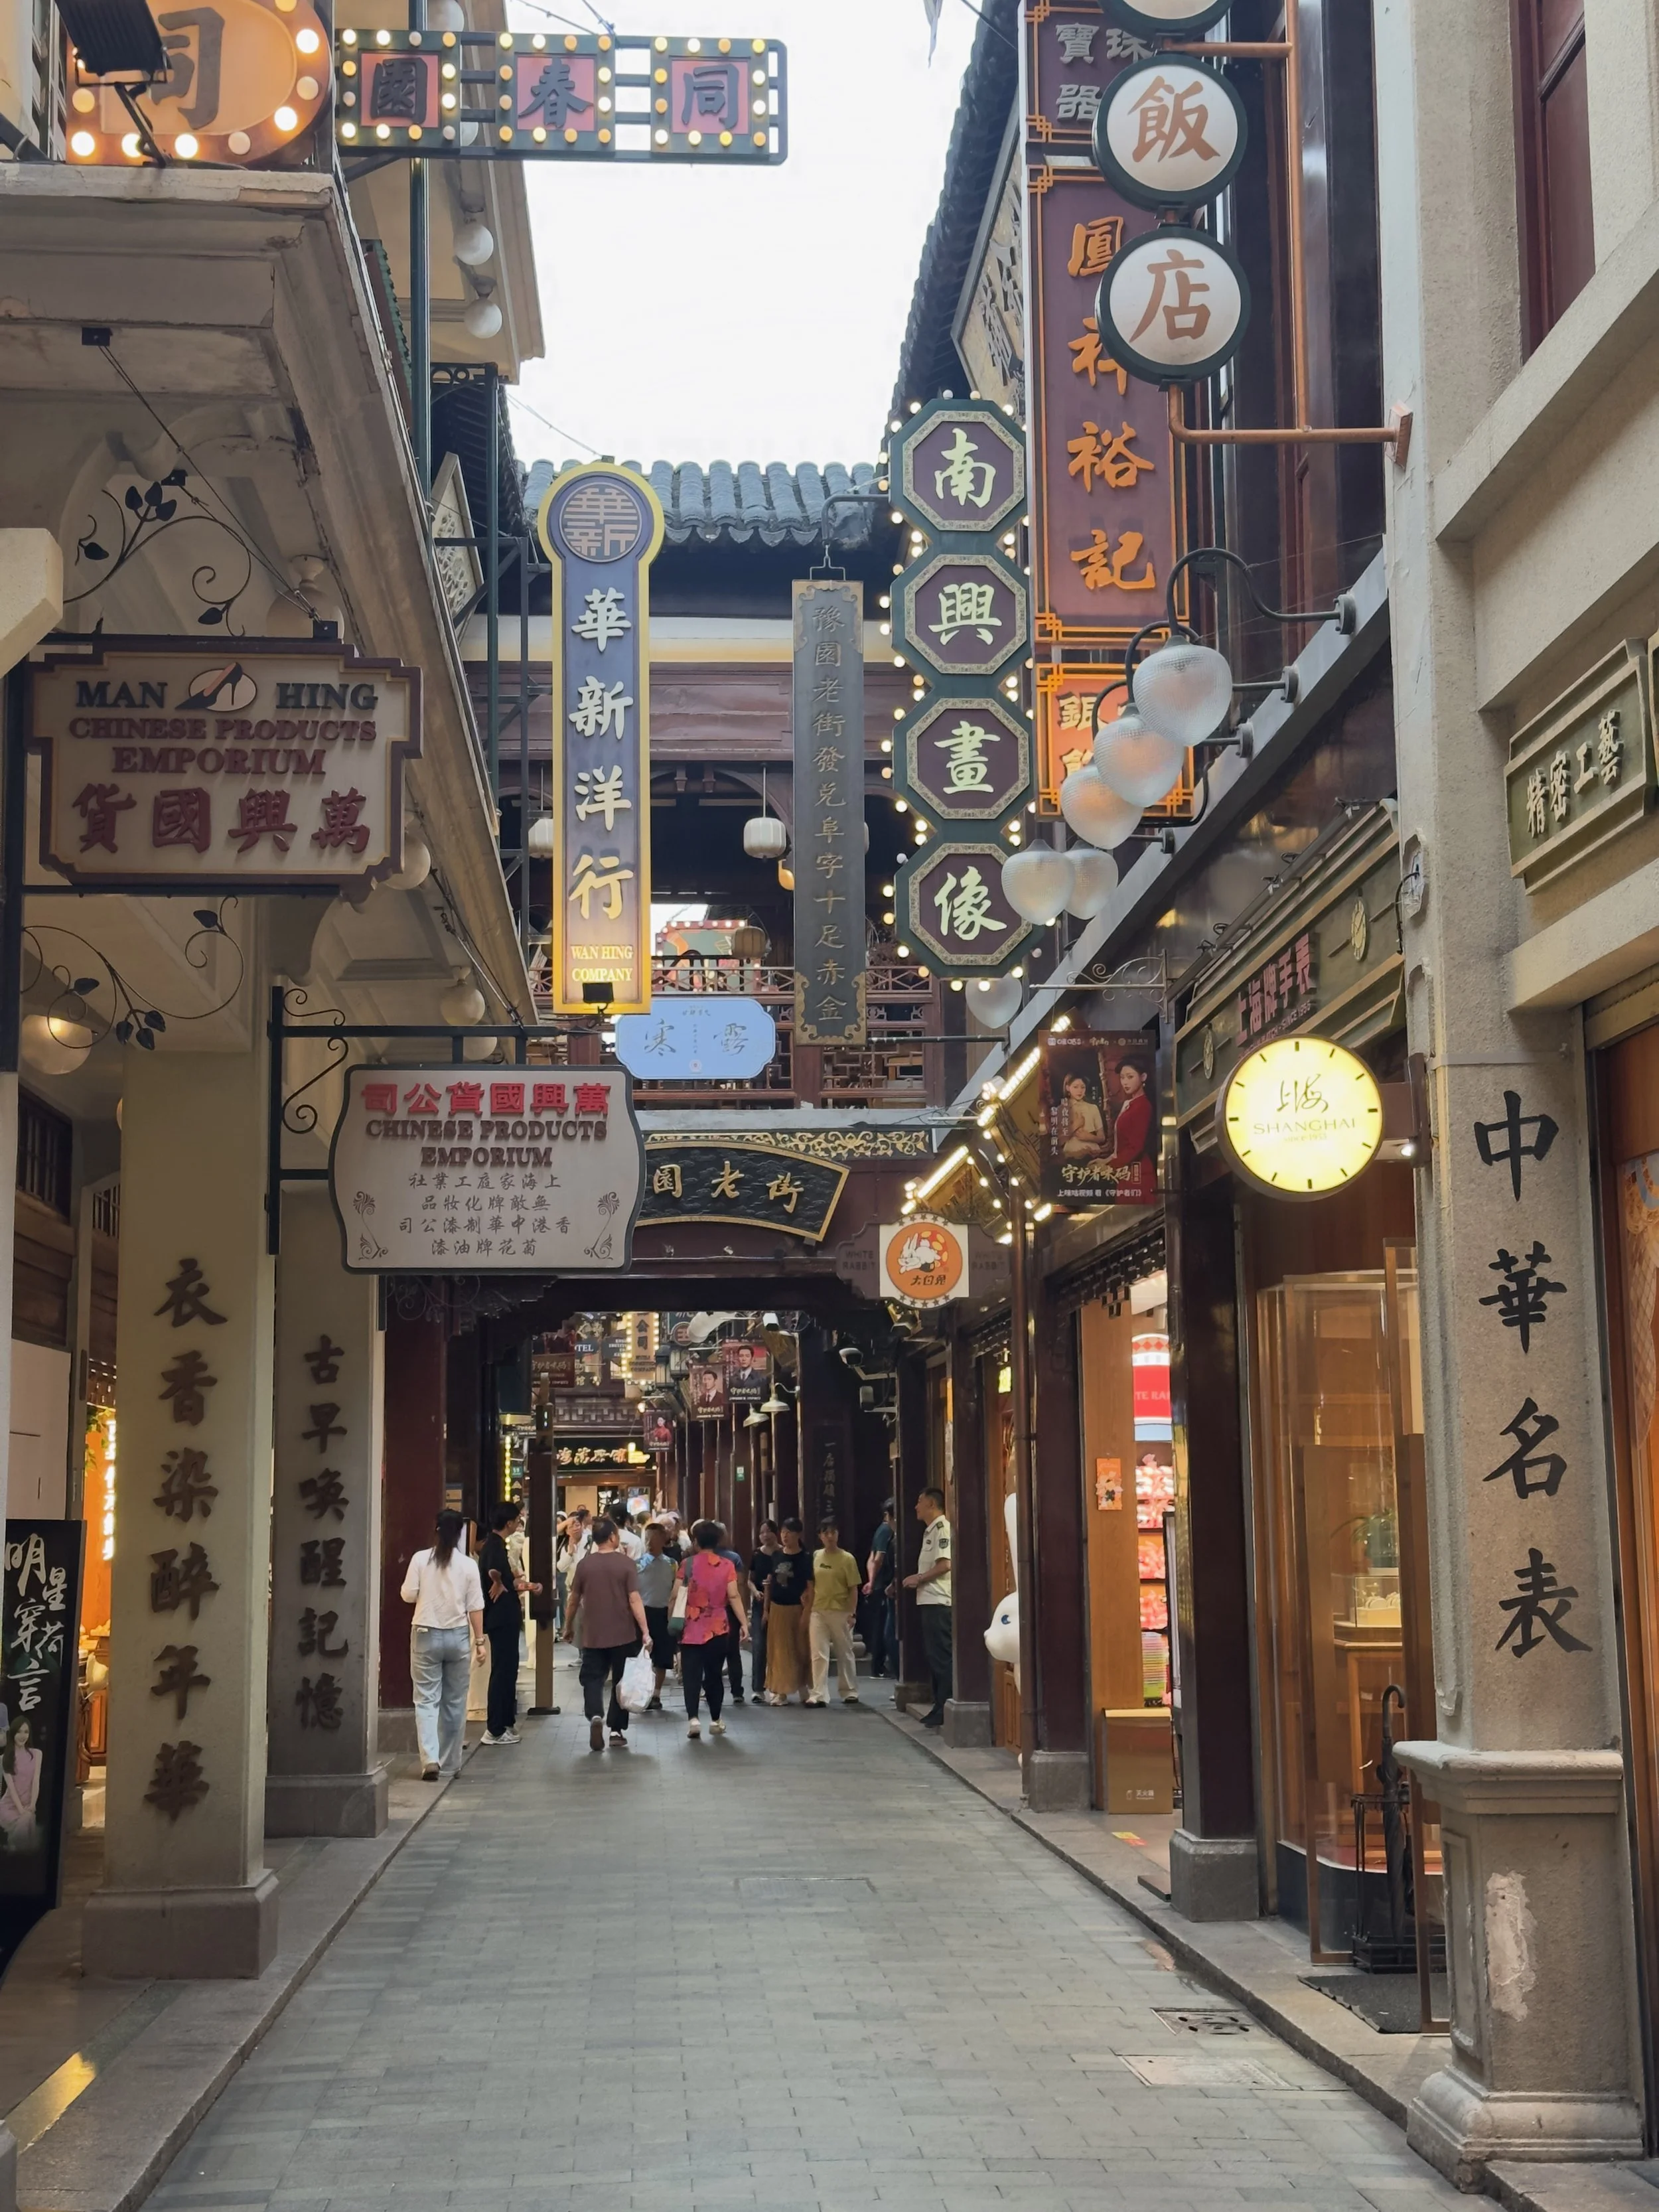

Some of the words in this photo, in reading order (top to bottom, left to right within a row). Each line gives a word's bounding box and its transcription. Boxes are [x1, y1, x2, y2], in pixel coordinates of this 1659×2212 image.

[1127, 75, 1220, 344] 飯店
[76, 681, 168, 708] MAN
[275, 682, 378, 709] HING
[928, 427, 1007, 941] 南興畫像
[69, 717, 208, 740] CHINESE
[214, 719, 377, 741] PRODUCTS
[111, 747, 326, 775] EMPORIUM
[569, 587, 634, 921] 華新洋行
[571, 945, 600, 960] WAN
[601, 944, 634, 960] HING
[571, 967, 633, 982] COMPANY
[366, 1119, 474, 1141] CHINESE
[480, 1119, 608, 1141] PRODUCTS
[1254, 1118, 1355, 1135] SHANGHAI
[420, 1147, 553, 1167] EMPORIUM
[842, 1262, 877, 1271] RABBIT
[845, 1250, 875, 1259] WHITE
[1473, 1090, 1593, 1659] 中華名表
[143, 1257, 228, 1822] 衣香染醉年華
